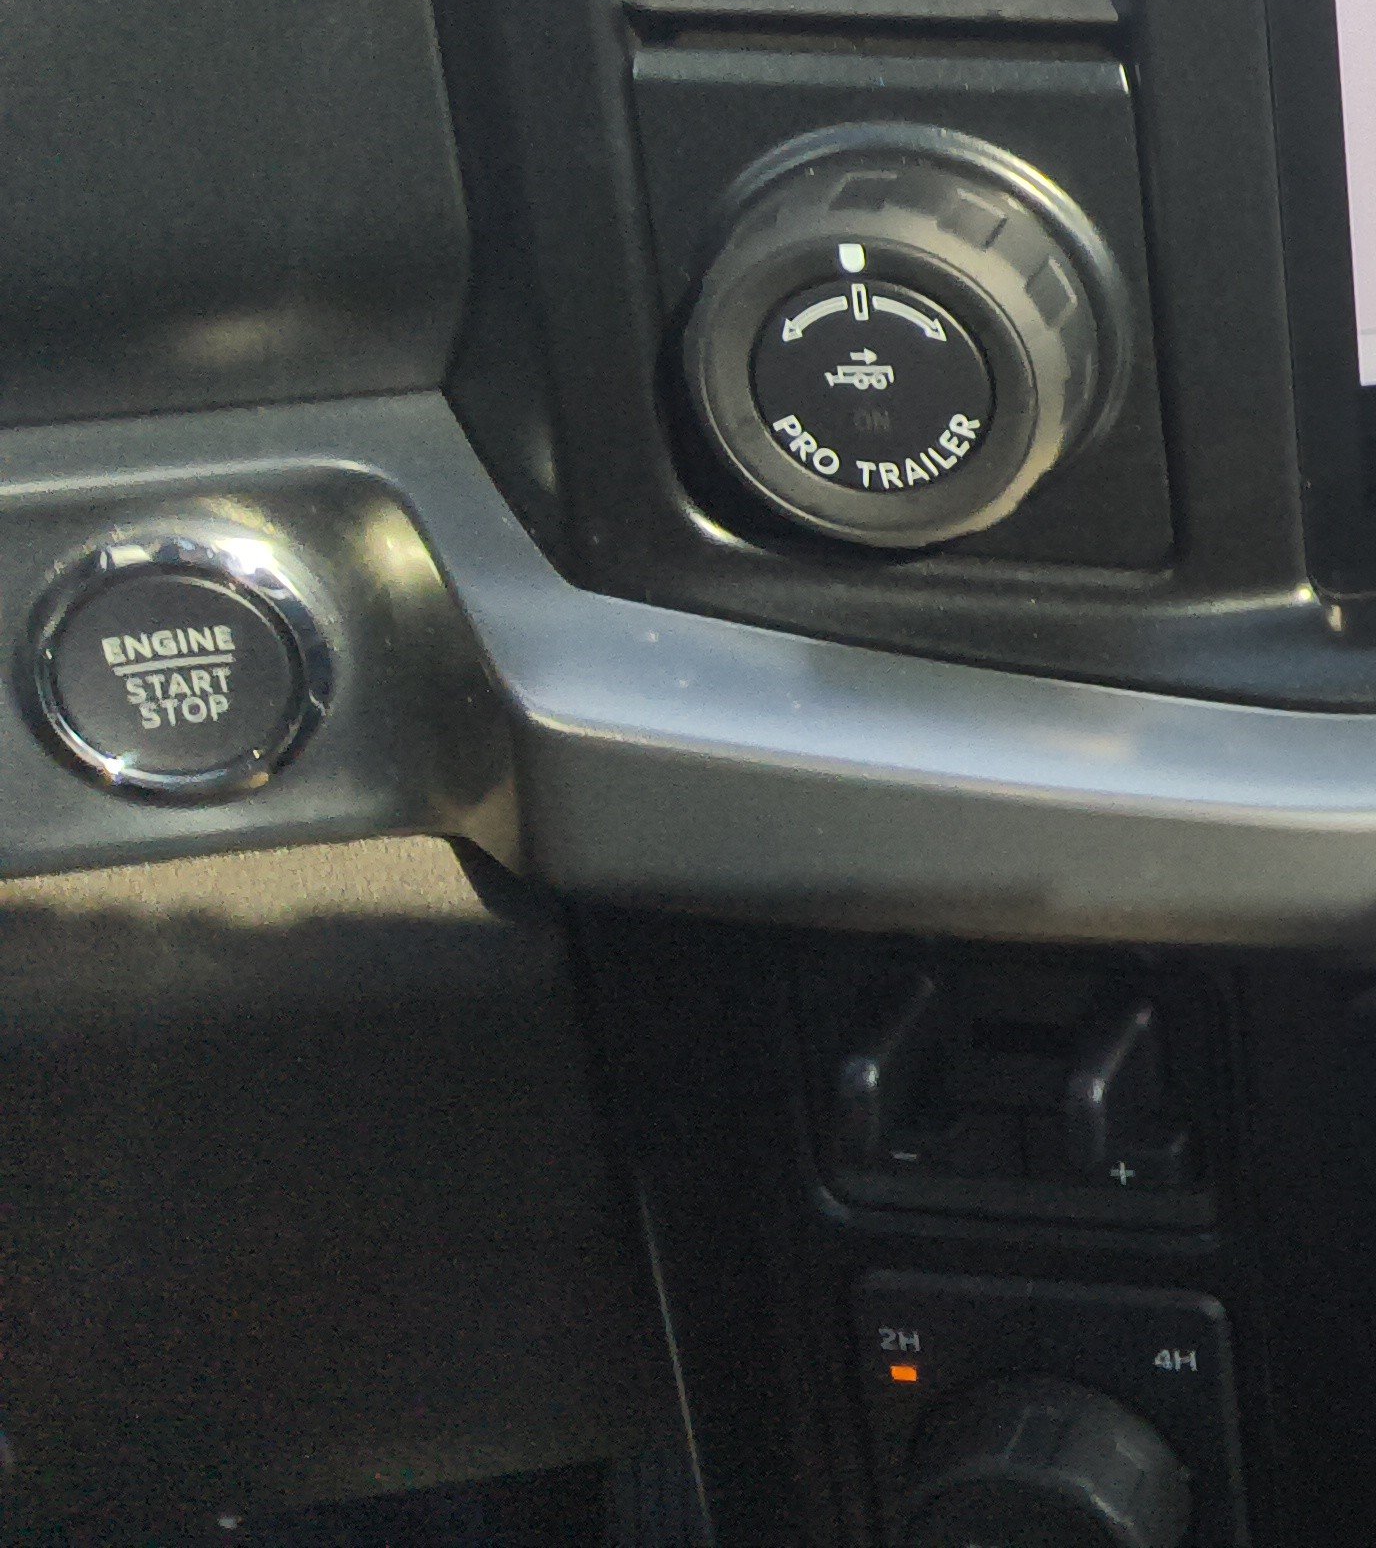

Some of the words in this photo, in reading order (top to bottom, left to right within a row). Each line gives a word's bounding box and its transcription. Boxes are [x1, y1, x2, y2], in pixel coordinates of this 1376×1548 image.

[773, 414, 840, 474] PRO
[856, 413, 980, 489] TRAILER
[102, 624, 235, 666] ENGINE
[126, 666, 231, 704] START
[138, 694, 229, 729] STOP
[878, 1328, 920, 1352] 2H
[1154, 1349, 1198, 1372] 4H
